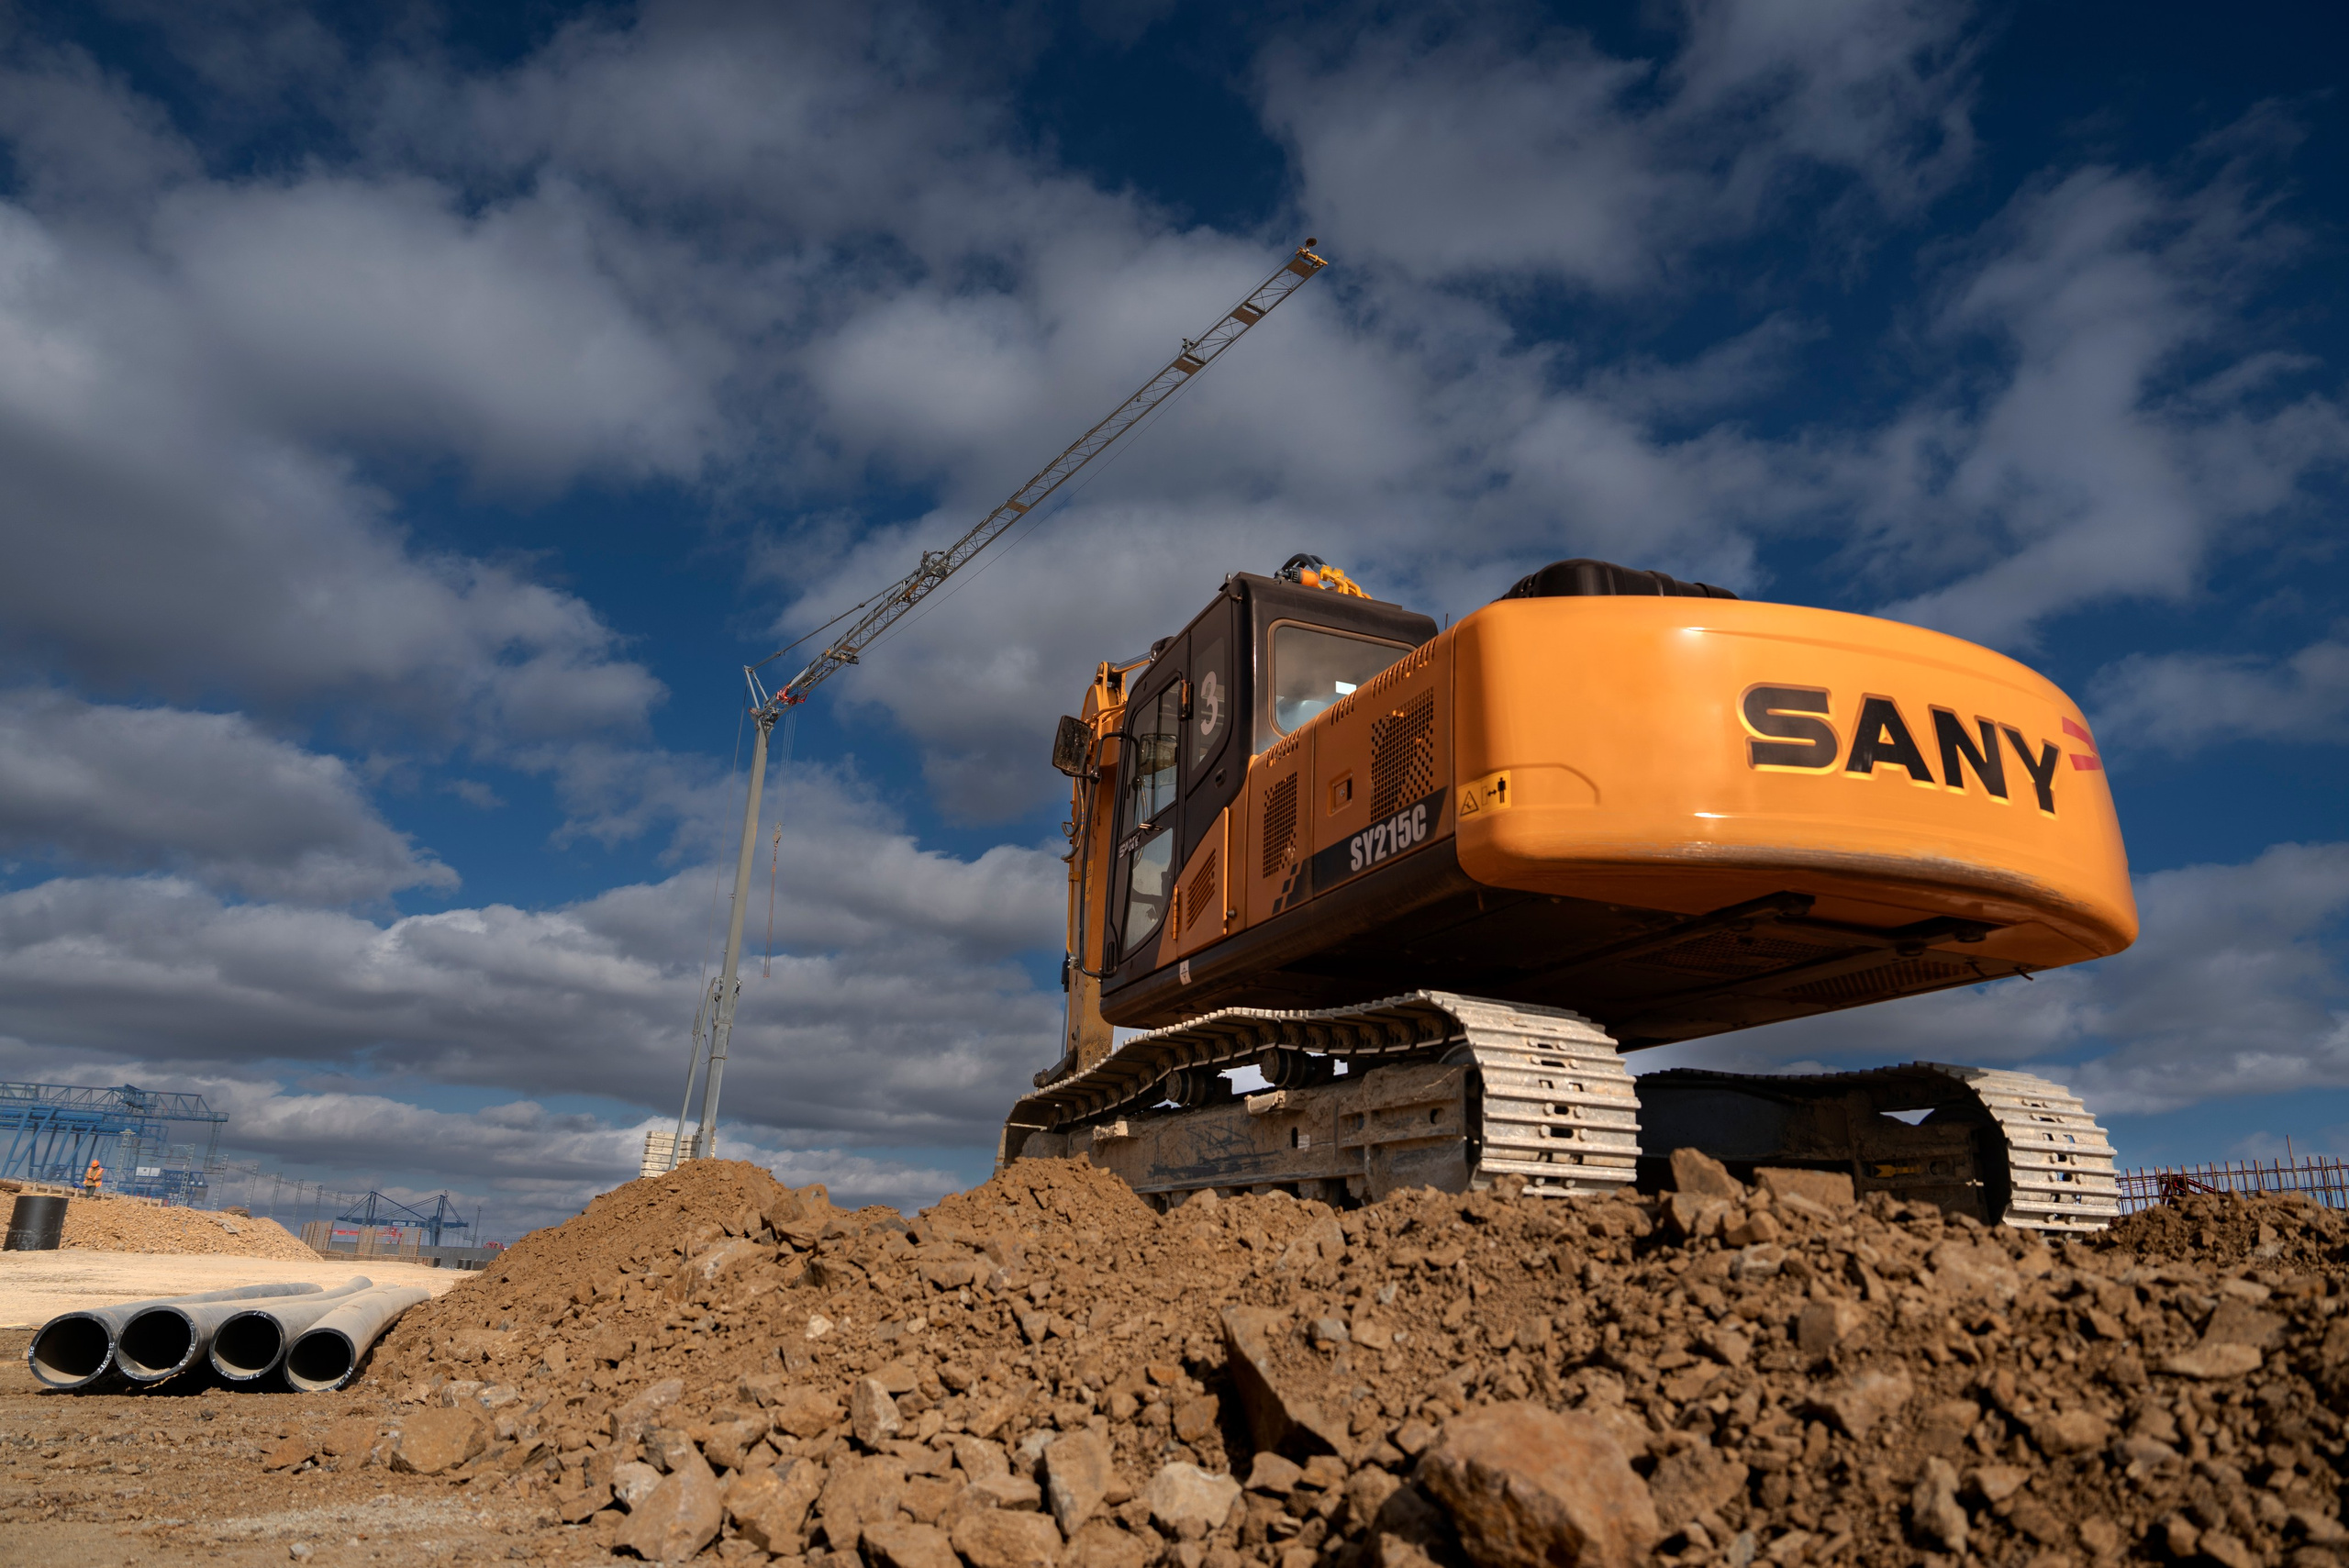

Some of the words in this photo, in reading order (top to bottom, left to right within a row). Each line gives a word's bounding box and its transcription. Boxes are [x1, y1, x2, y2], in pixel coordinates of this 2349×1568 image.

[1200, 671, 1219, 736] 3
[1737, 683, 2060, 819] SANY
[1350, 804, 1427, 872] SY215C
